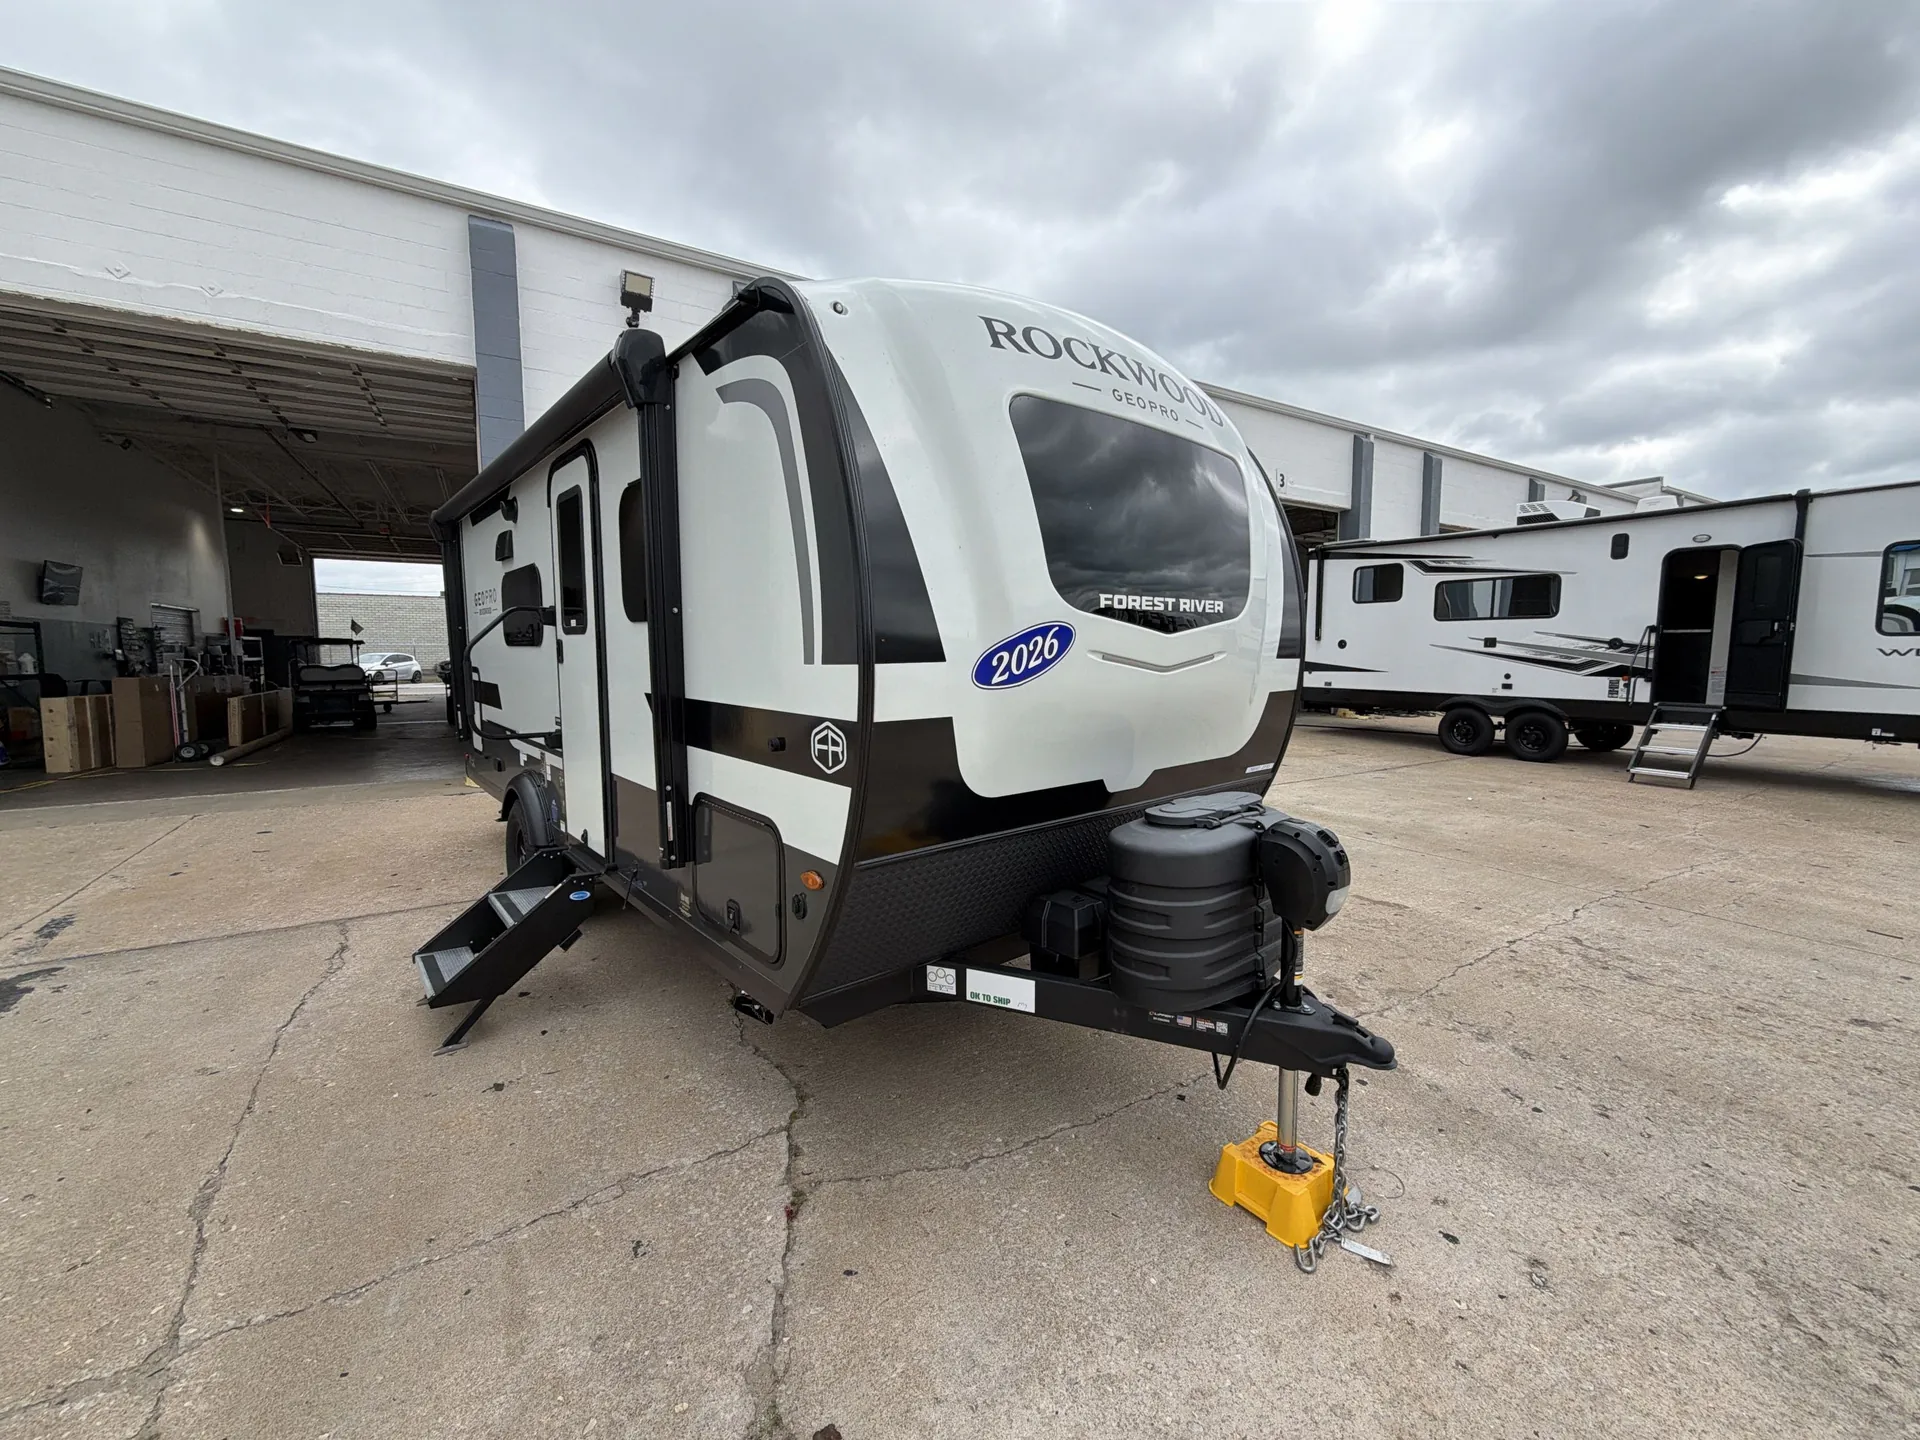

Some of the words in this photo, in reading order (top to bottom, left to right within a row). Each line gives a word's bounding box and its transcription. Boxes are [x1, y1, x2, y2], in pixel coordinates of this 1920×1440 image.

[977, 314, 1224, 428] ROCKWOOD
[1111, 388, 1180, 422] GEOPRO
[1279, 473, 1285, 488] 3
[474, 588, 497, 606] GEOPRO
[1098, 593, 1176, 611] FOREST
[1179, 598, 1224, 613] RIVER
[991, 626, 1060, 686] 2026
[969, 991, 981, 1000] OK
[982, 993, 992, 1002] TO
[993, 996, 1011, 1006] SHIP
